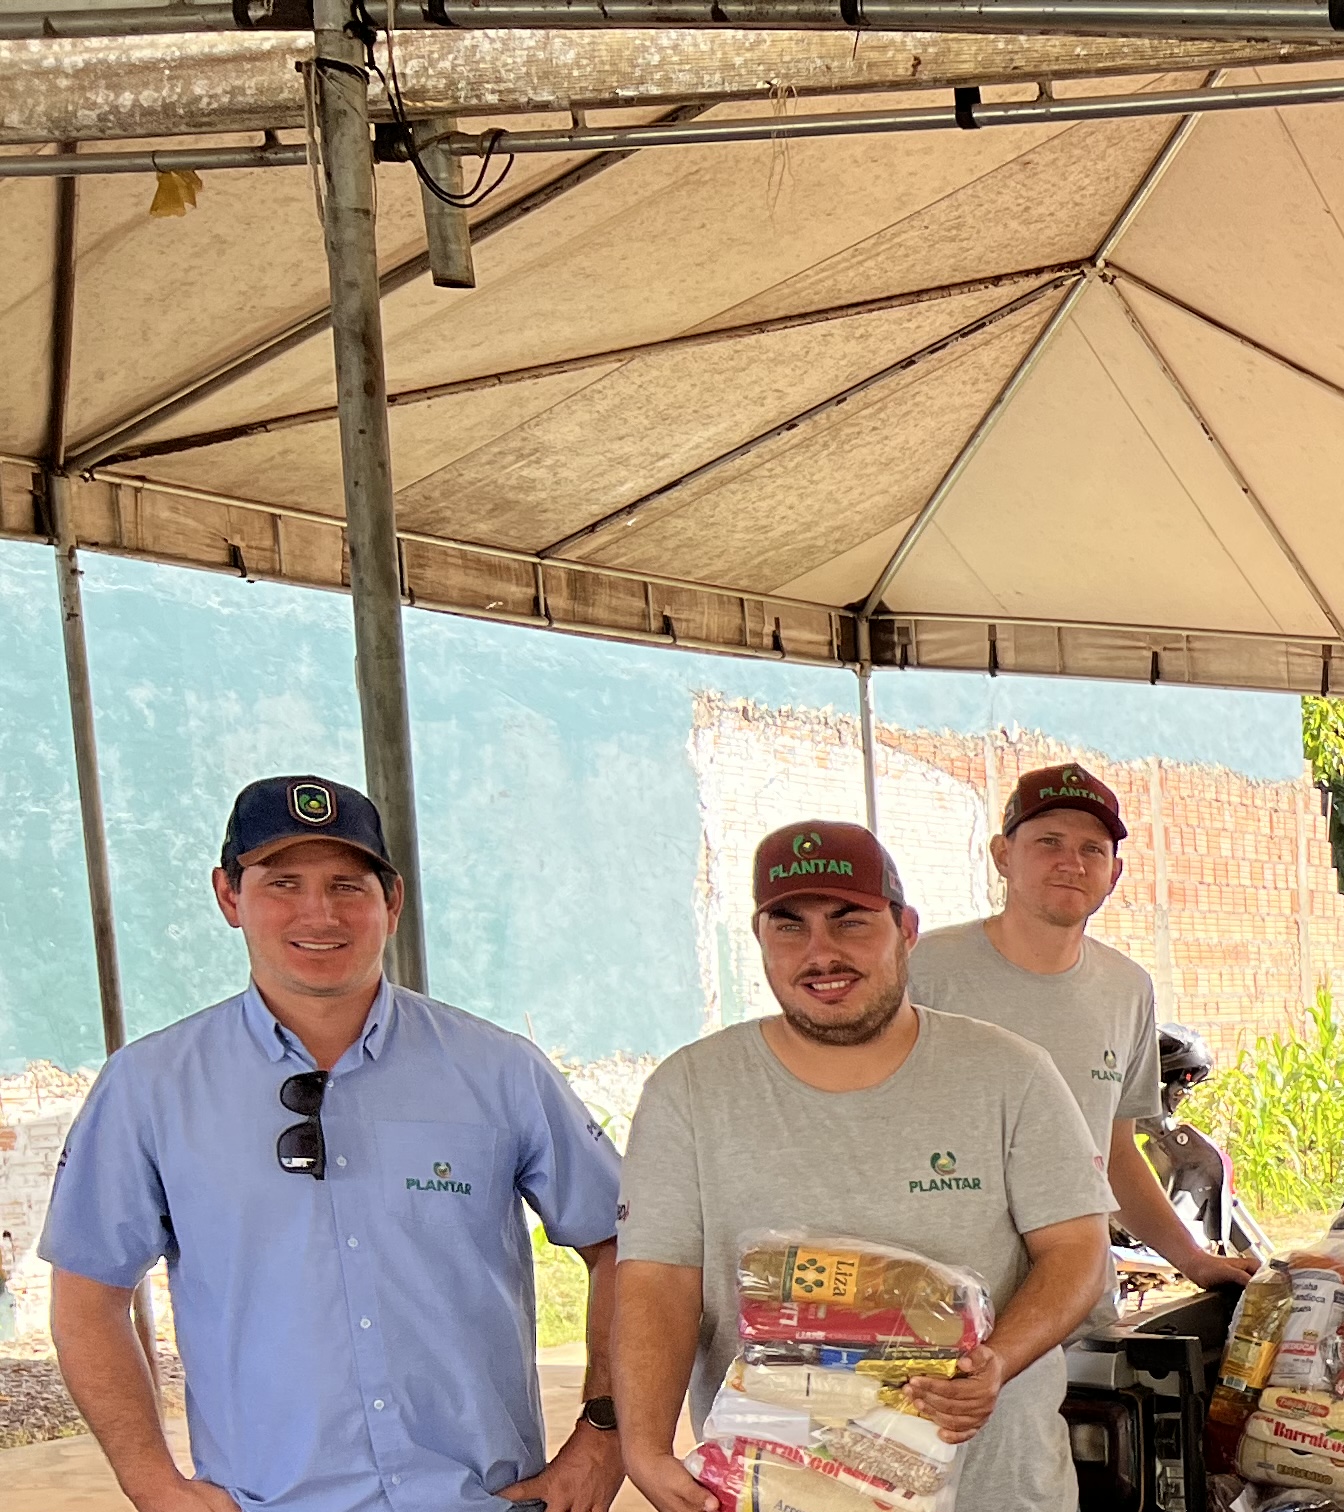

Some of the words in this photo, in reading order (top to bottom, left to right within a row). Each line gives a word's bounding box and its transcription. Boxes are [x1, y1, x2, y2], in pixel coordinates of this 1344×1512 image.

[769, 859, 853, 883] PLANTAR
[406, 1178, 472, 1195] PLANTAR
[909, 1178, 982, 1193] PLANTAR
[832, 1260, 855, 1297] Liza
